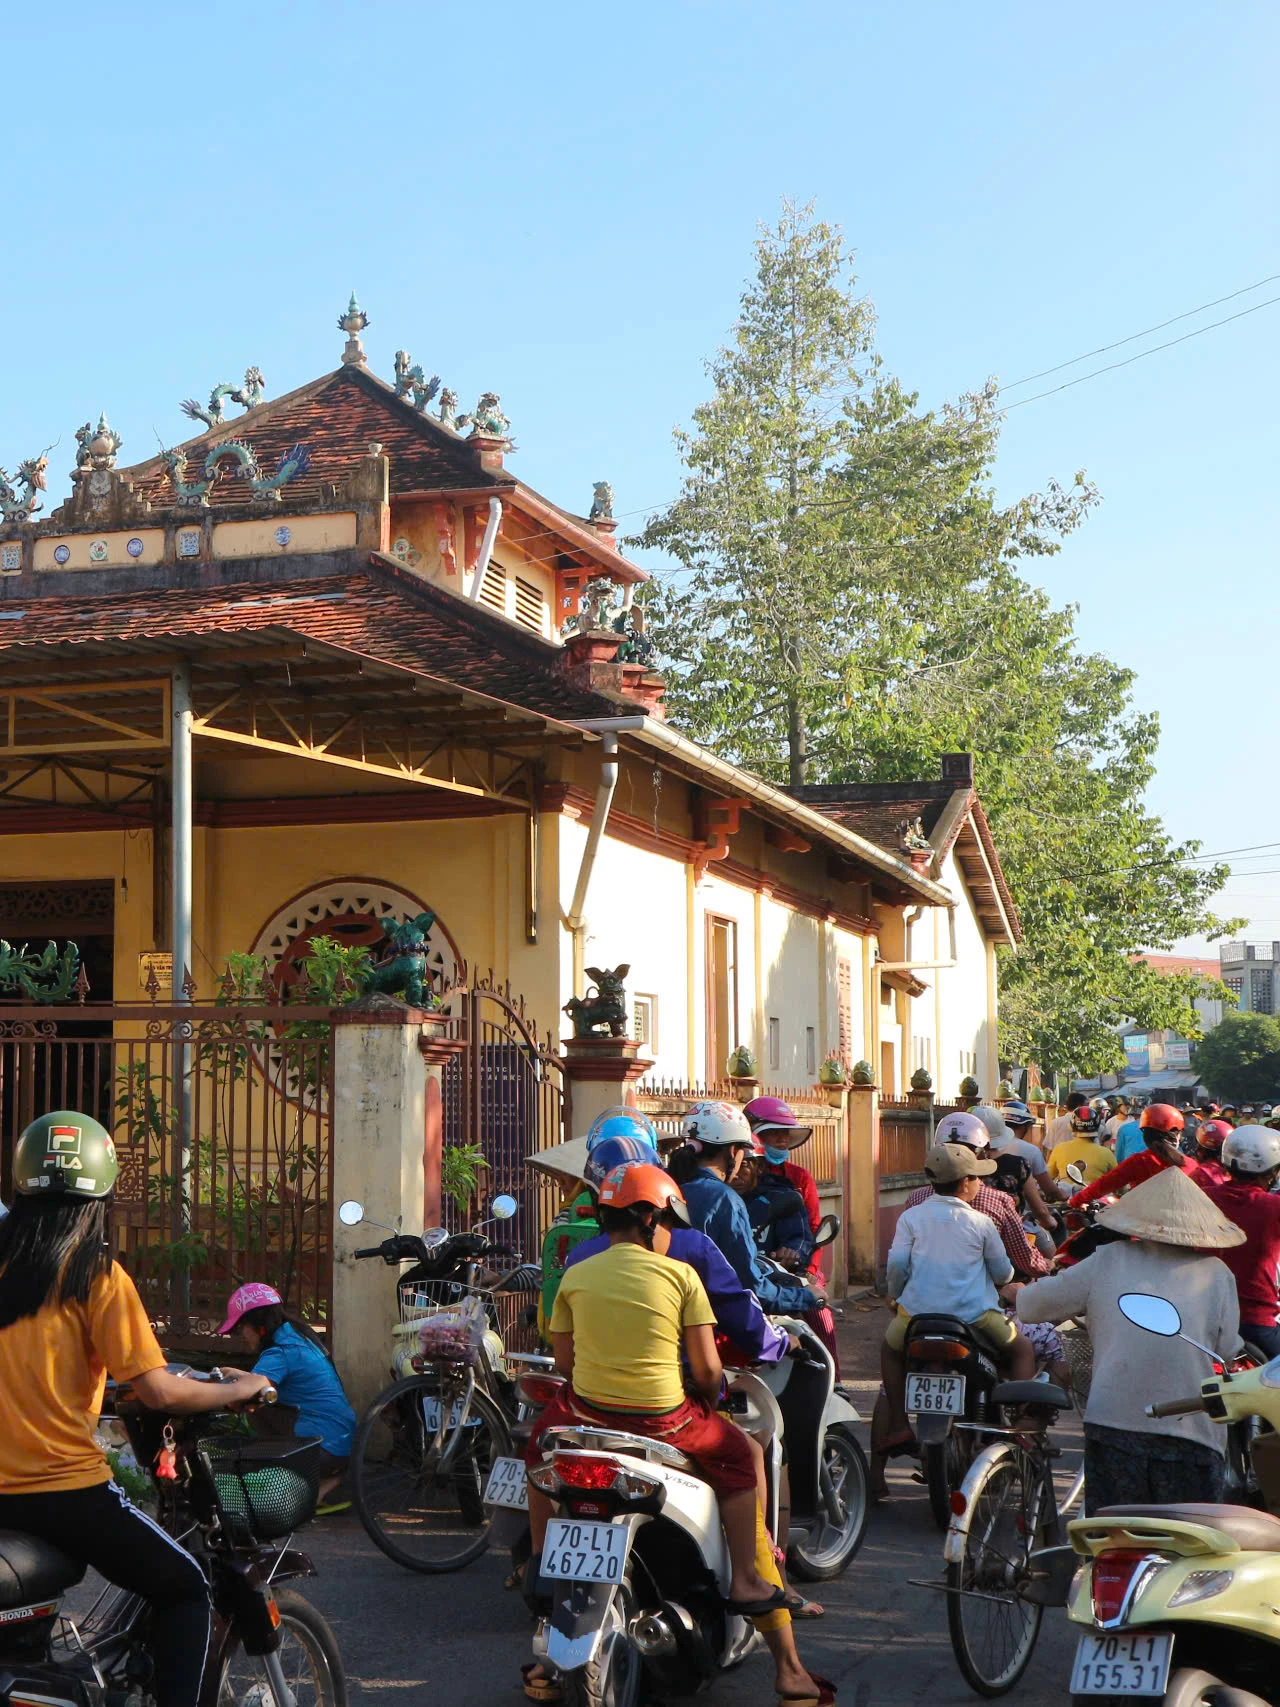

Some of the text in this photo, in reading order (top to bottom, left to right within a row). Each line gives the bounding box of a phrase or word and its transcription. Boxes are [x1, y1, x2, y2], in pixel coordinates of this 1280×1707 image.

[43, 1155, 83, 1170] FILA
[915, 1378, 956, 1394] 70-H7
[914, 1393, 953, 1411] 5684
[500, 1461, 527, 1482] 70-L
[487, 1481, 528, 1505] 273.8
[558, 1524, 614, 1551] 70-L1
[546, 1549, 619, 1579] 467.20
[0, 1607, 35, 1623] HONDA
[1091, 1636, 1156, 1662] 70-L1
[1082, 1664, 1160, 1690] 155.31
